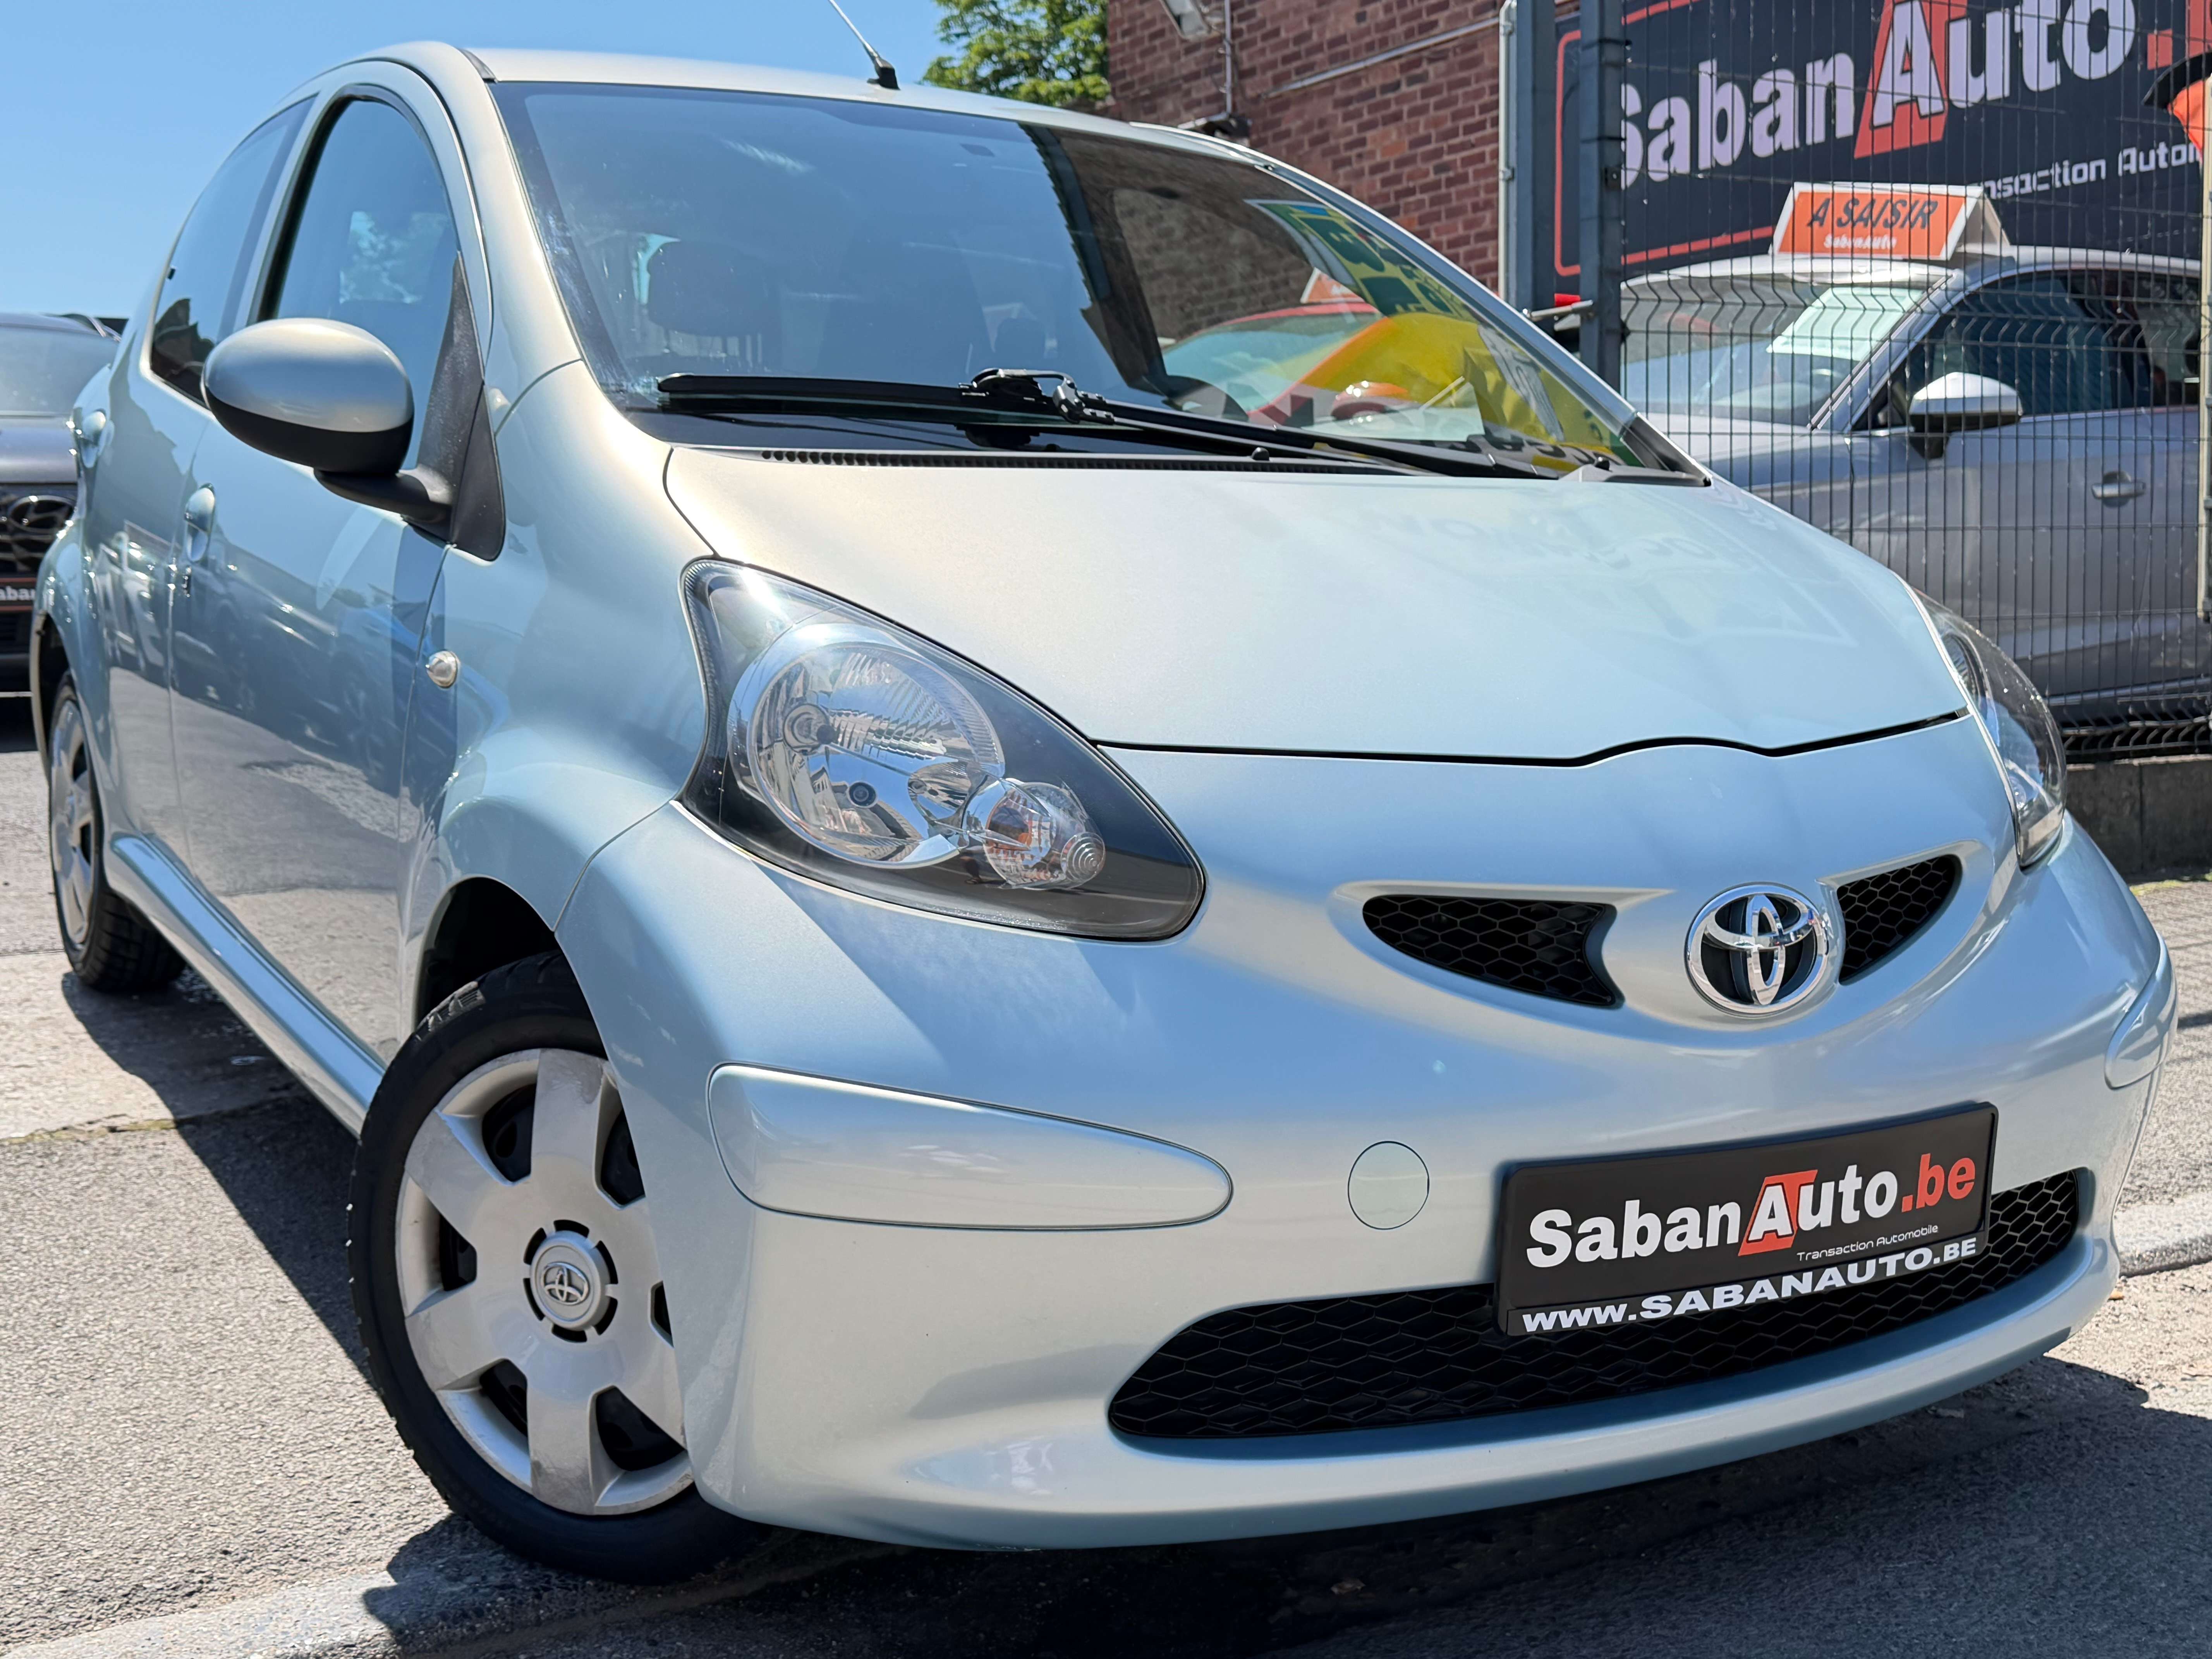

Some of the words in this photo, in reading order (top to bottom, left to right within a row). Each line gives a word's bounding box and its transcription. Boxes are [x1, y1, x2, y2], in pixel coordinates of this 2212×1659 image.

[1984, 160, 2106, 199] nsaction
[1807, 198, 1831, 228] A
[1836, 198, 1938, 229] SAISIR
[1527, 1153, 1975, 1267] SabanAuto.be
[1797, 1239, 1874, 1261] Transaction
[1876, 1224, 1938, 1246] Automobile
